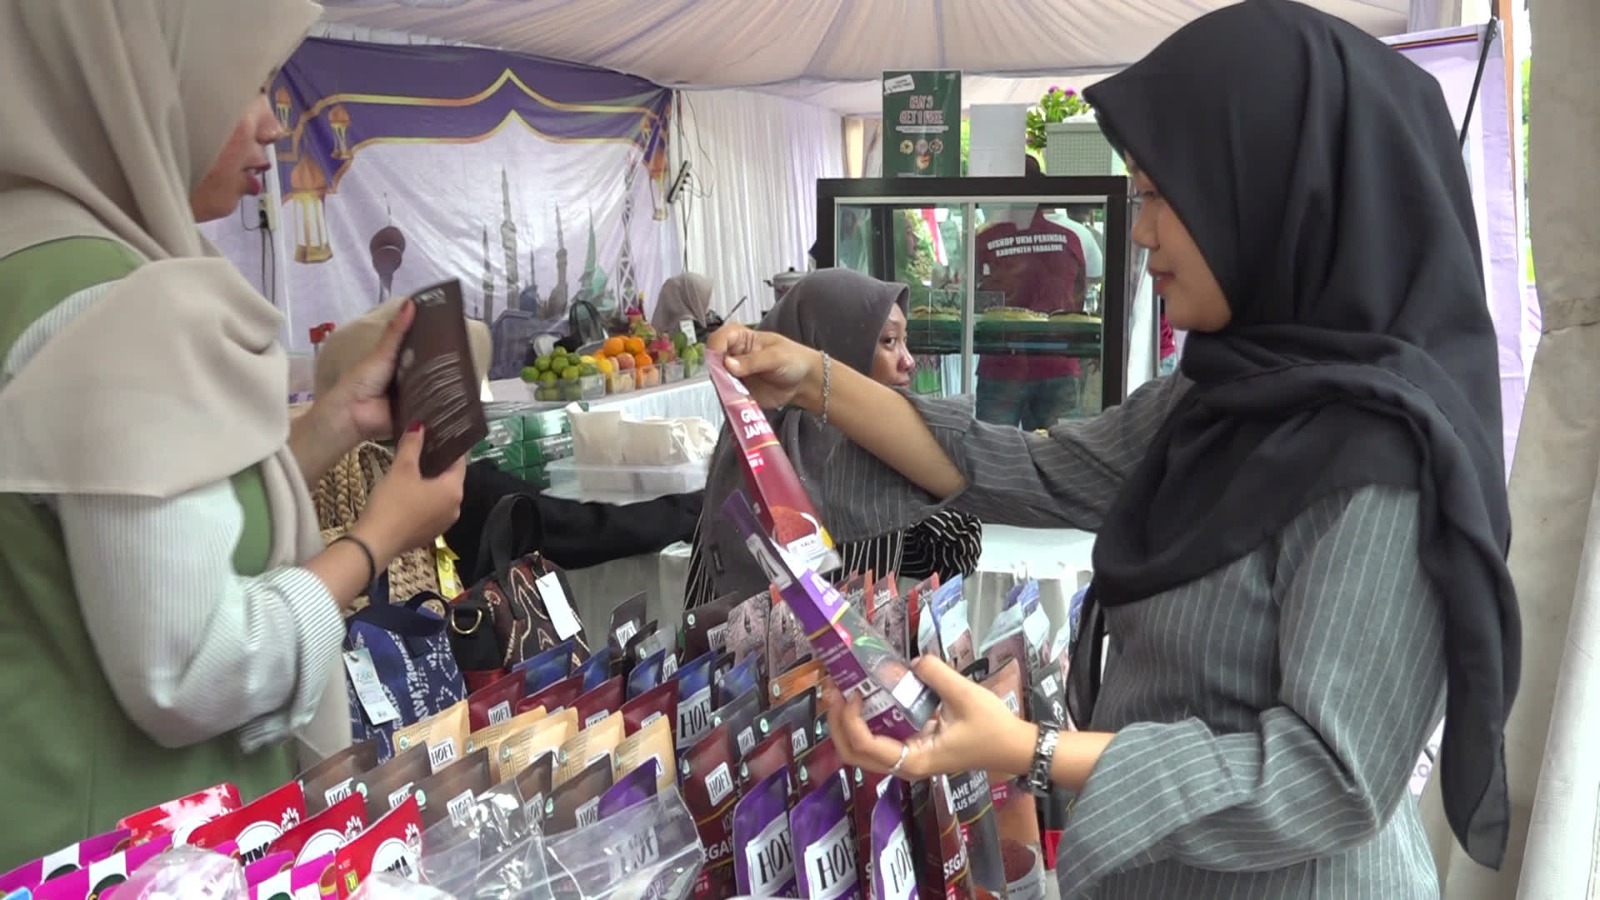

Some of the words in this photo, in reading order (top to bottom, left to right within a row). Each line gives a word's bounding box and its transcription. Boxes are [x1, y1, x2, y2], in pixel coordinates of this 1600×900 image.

[680, 697, 711, 738] HOF
[757, 828, 792, 886] HOF
[815, 834, 855, 891] HOF
